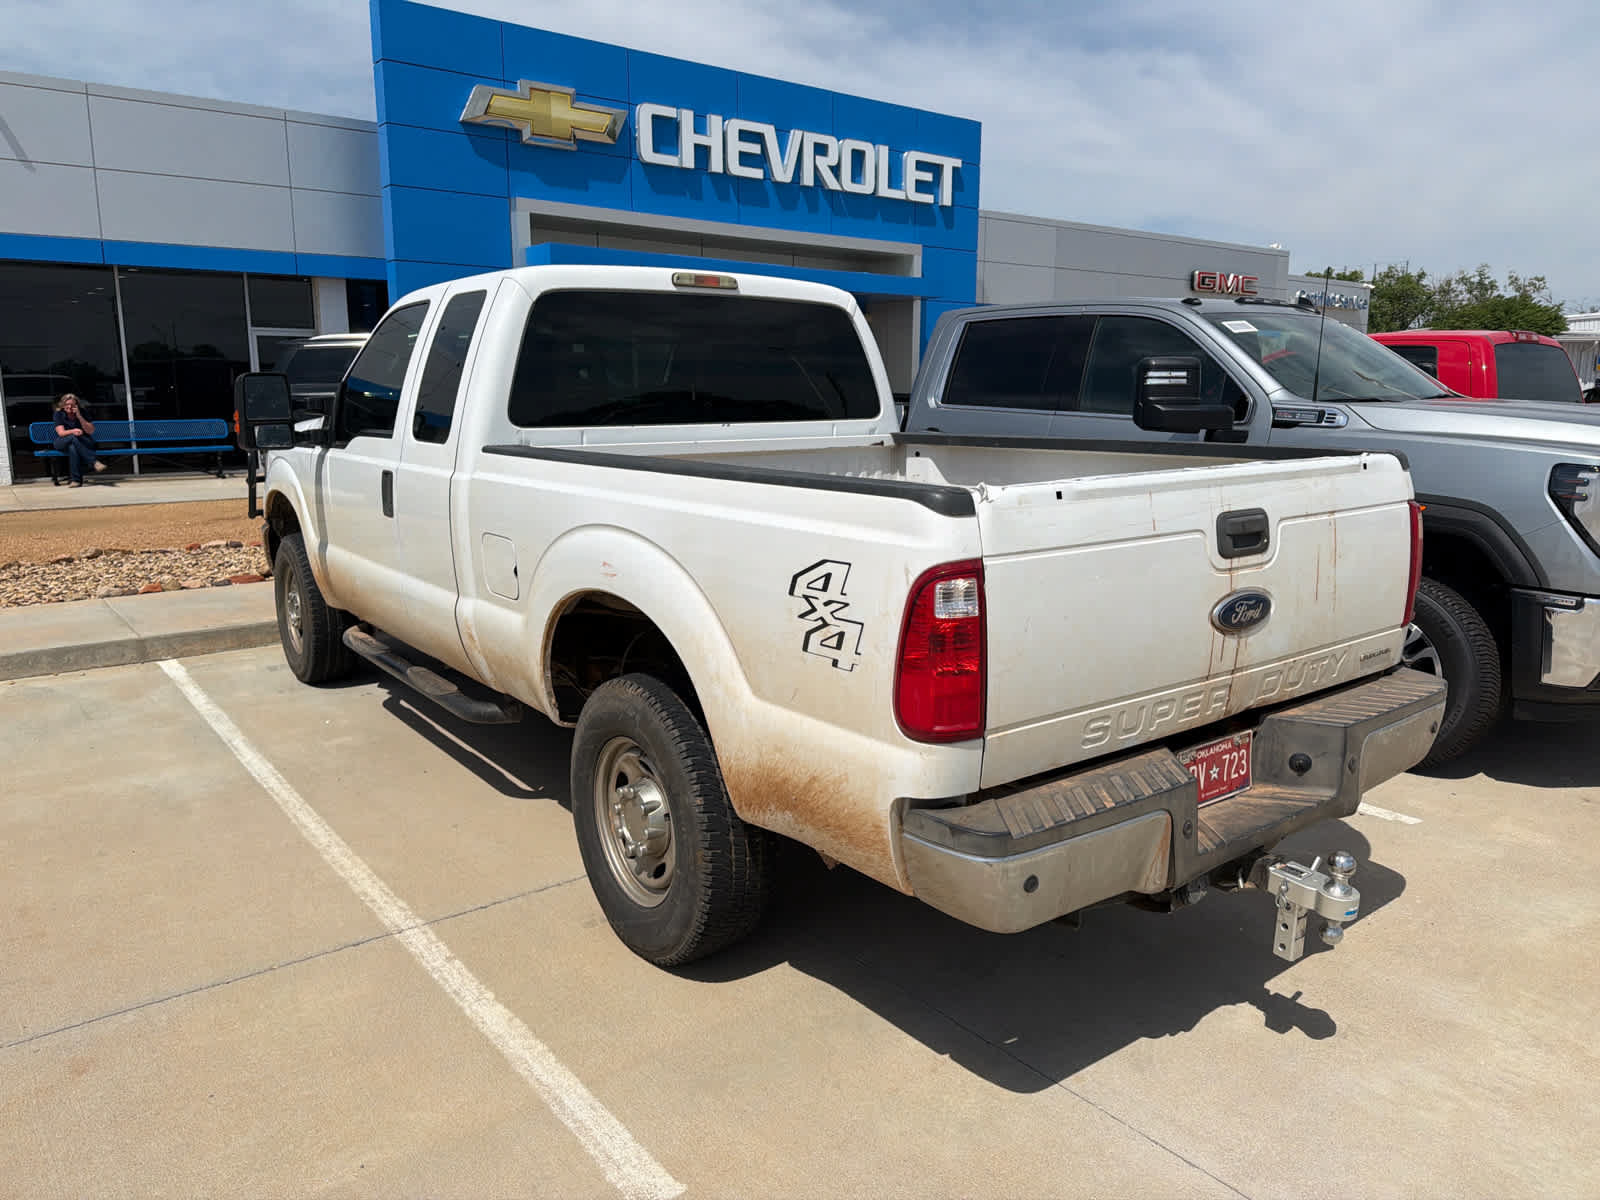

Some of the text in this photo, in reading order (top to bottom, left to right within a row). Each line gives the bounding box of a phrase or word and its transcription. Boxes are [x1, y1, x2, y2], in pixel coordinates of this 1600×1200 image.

[635, 102, 963, 207] CHEVROLET
[1192, 270, 1259, 296] GMC
[1231, 599, 1264, 624] Ford
[1081, 649, 1348, 750] SUPER DUTY
[1196, 741, 1233, 760] OKLAHOMA
